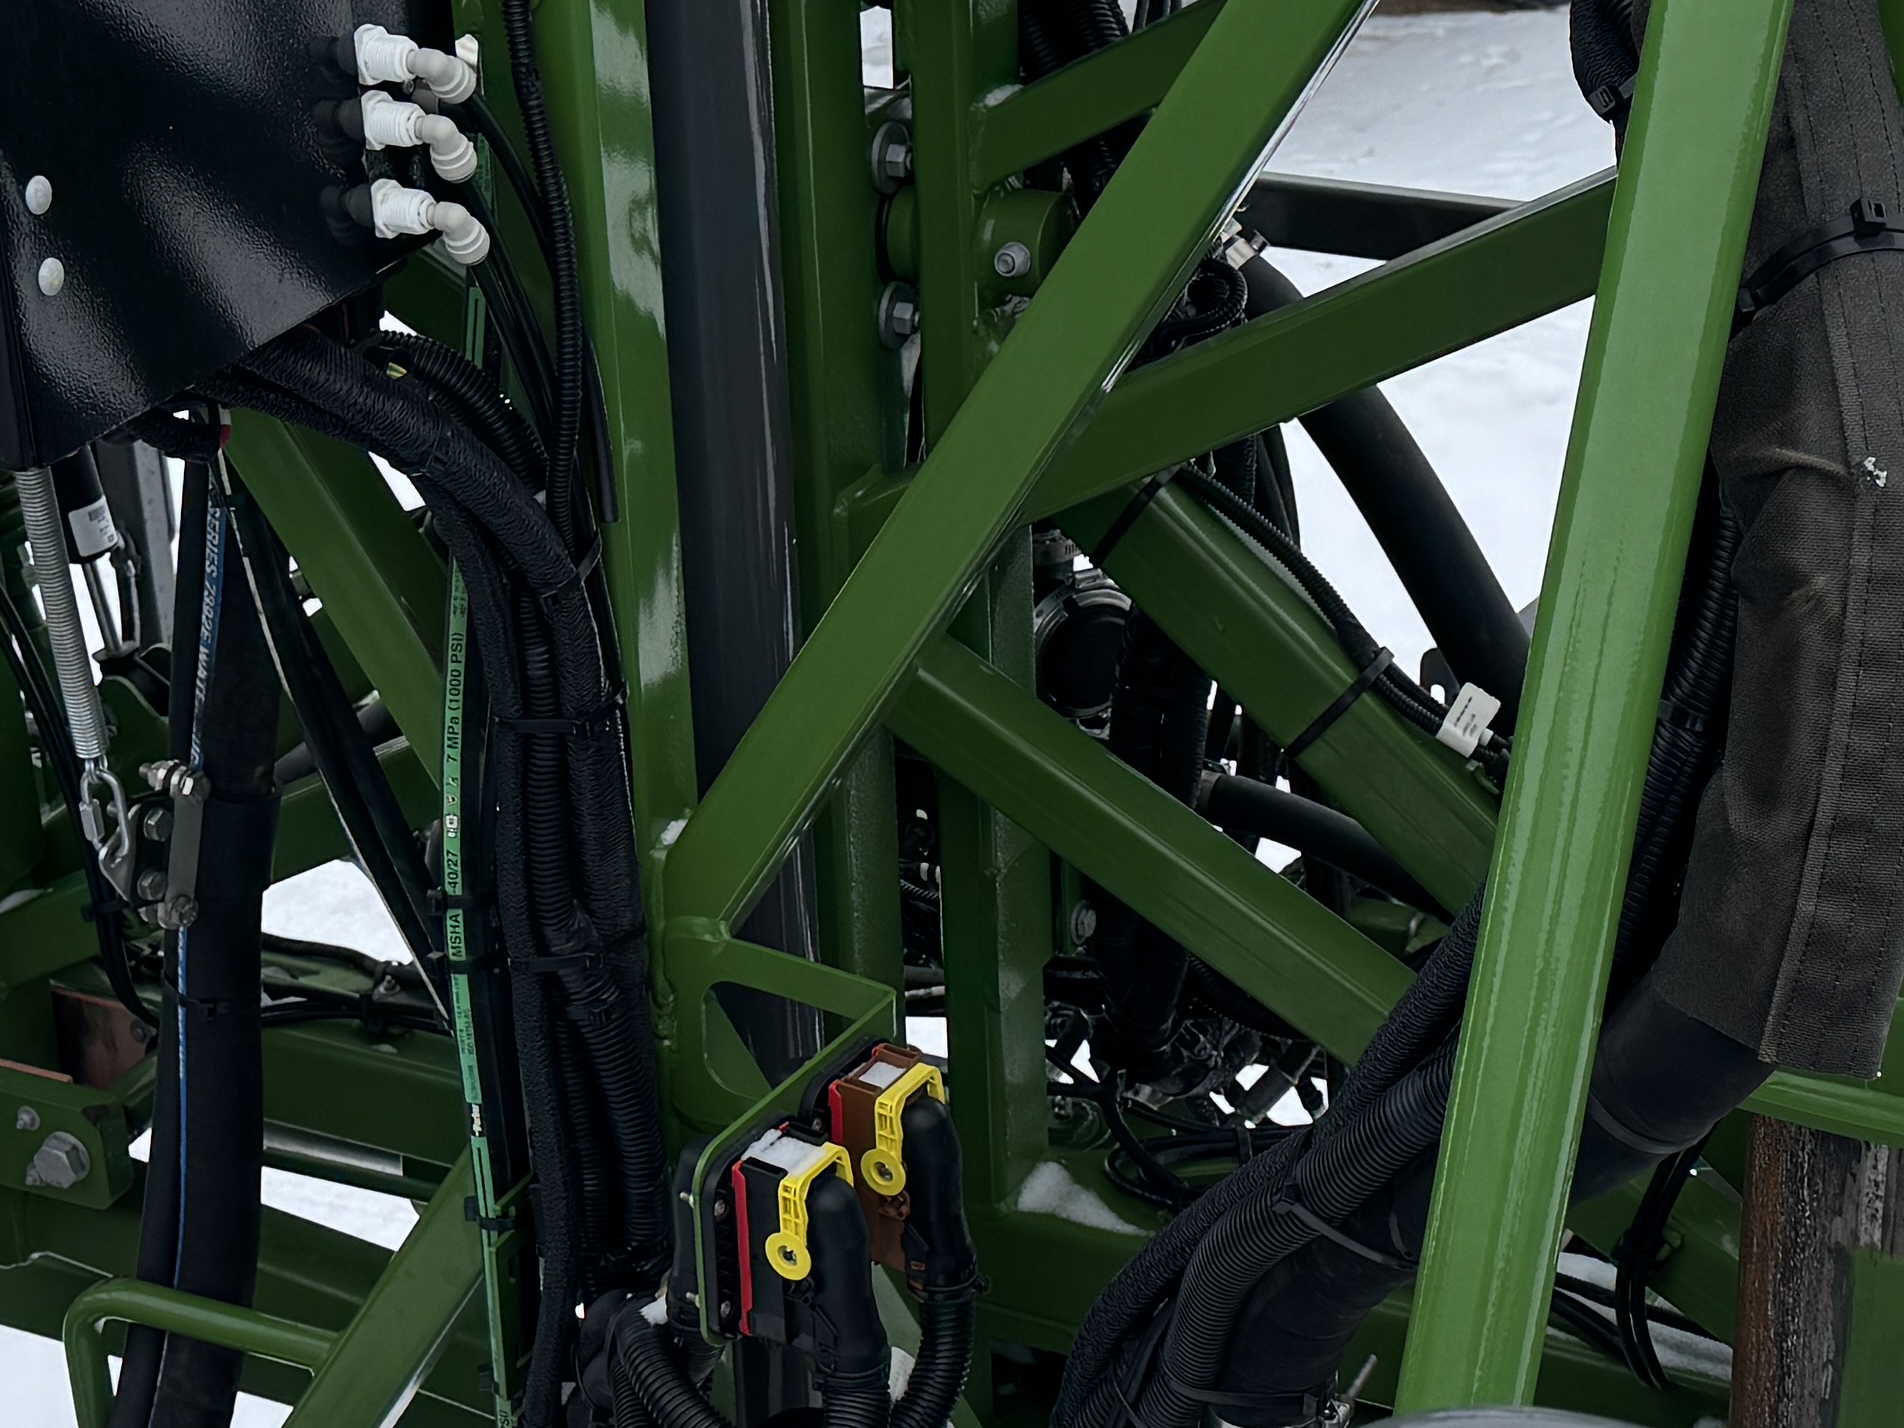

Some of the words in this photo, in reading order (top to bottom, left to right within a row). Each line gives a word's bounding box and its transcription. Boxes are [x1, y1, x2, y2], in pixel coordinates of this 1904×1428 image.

[205, 501, 221, 578] SERIES
[449, 632, 464, 664] PSI)
[447, 669, 462, 711] (1000
[447, 716, 460, 750] MPa
[451, 913, 463, 958] MSHA
